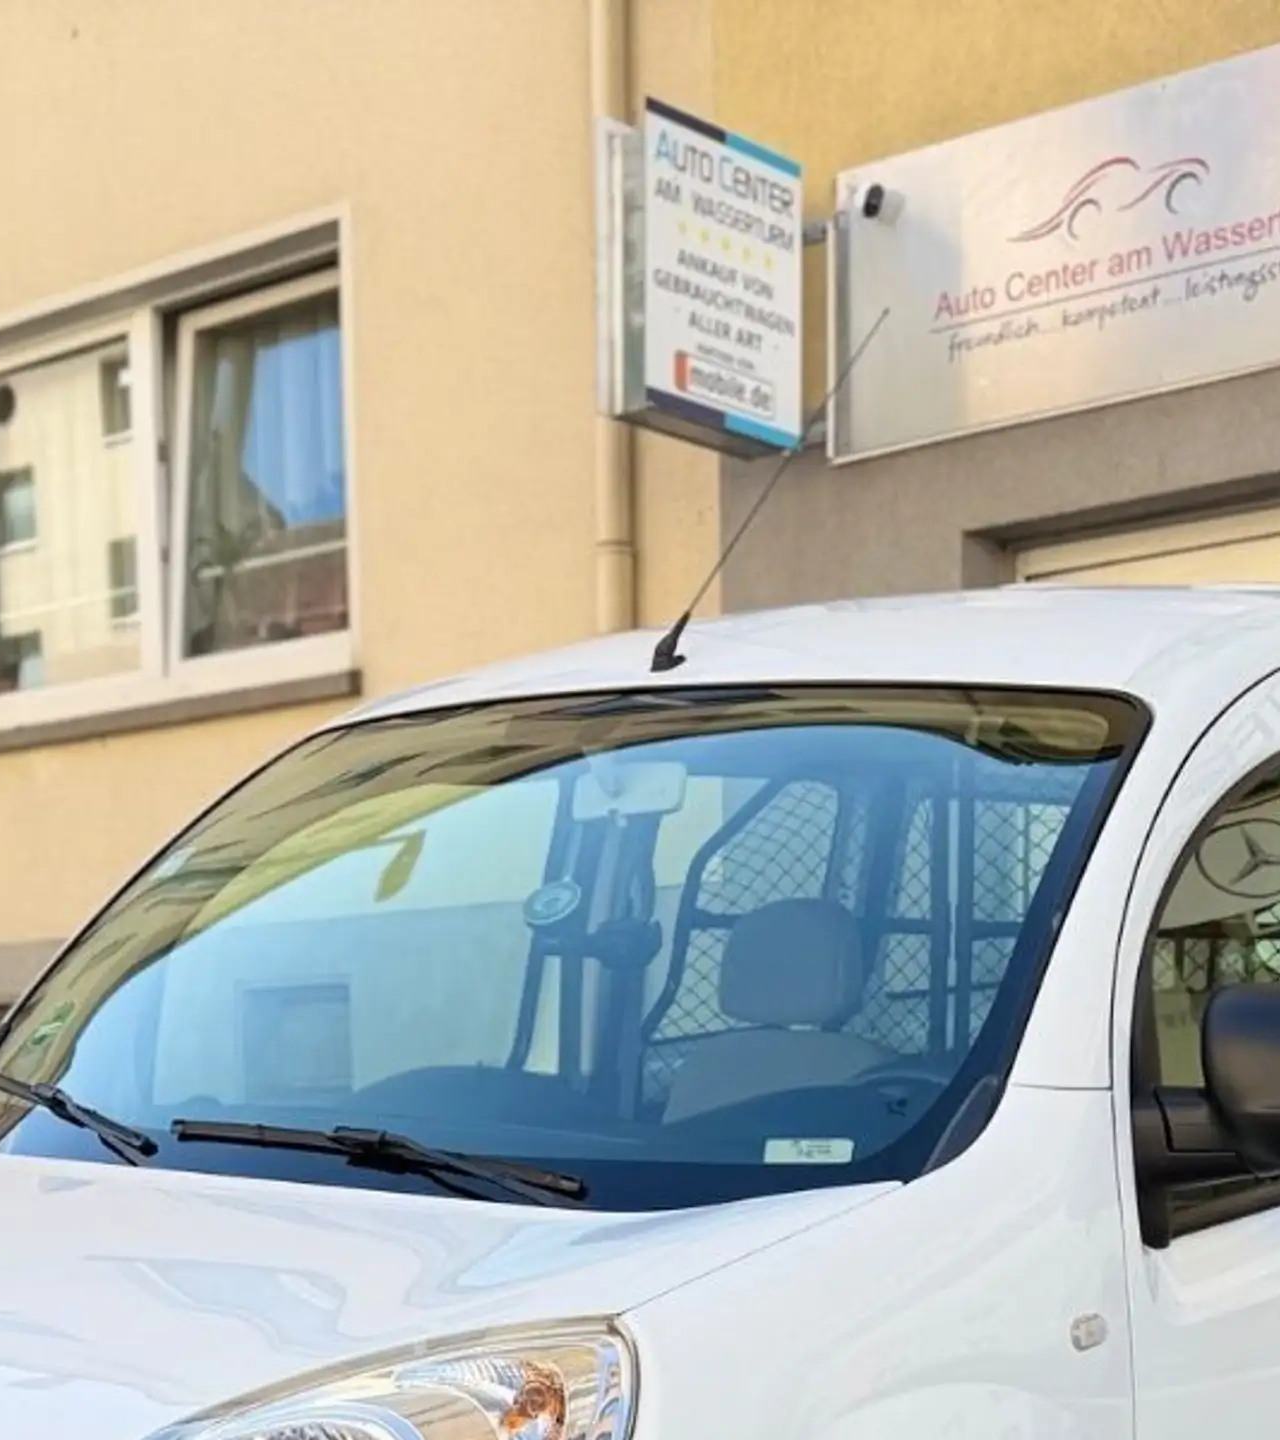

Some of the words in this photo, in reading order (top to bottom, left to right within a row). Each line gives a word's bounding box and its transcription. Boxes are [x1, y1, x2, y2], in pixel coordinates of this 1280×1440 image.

[677, 249, 738, 288] ANKAUF
[934, 285, 996, 322] Auto
[1005, 260, 1099, 302] Center
[1107, 246, 1153, 277] am
